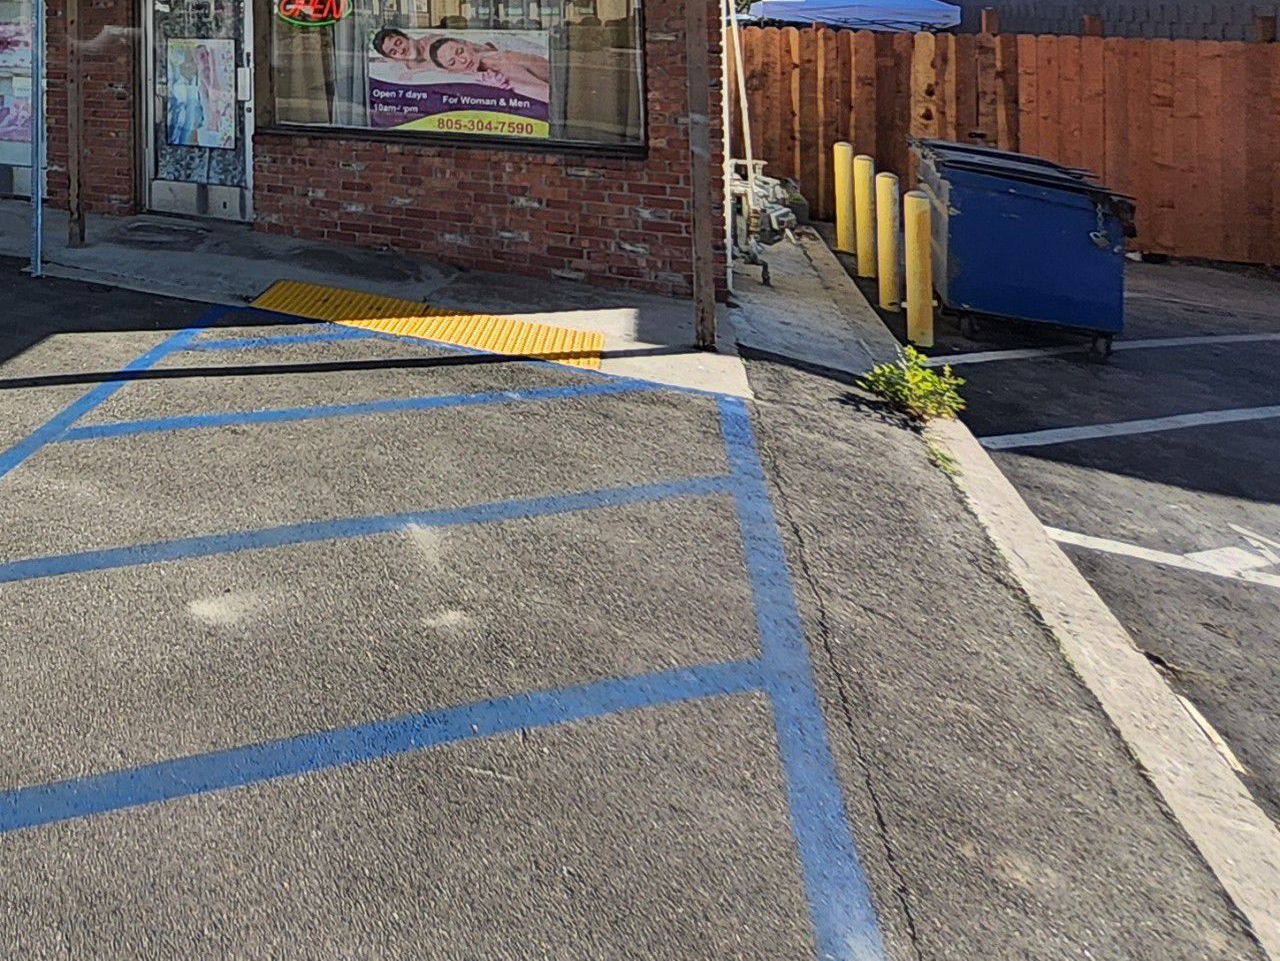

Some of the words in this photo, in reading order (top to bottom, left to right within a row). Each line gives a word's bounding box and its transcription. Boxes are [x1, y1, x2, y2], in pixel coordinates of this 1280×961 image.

[372, 89, 397, 100] Open
[398, 90, 404, 98] 7
[405, 90, 428, 101] days
[442, 95, 458, 105] For
[460, 96, 497, 106] Woman
[499, 98, 507, 107] &
[509, 98, 531, 108] Men
[373, 103, 419, 114] 10am-pm
[436, 118, 535, 135] 805-304-7590
